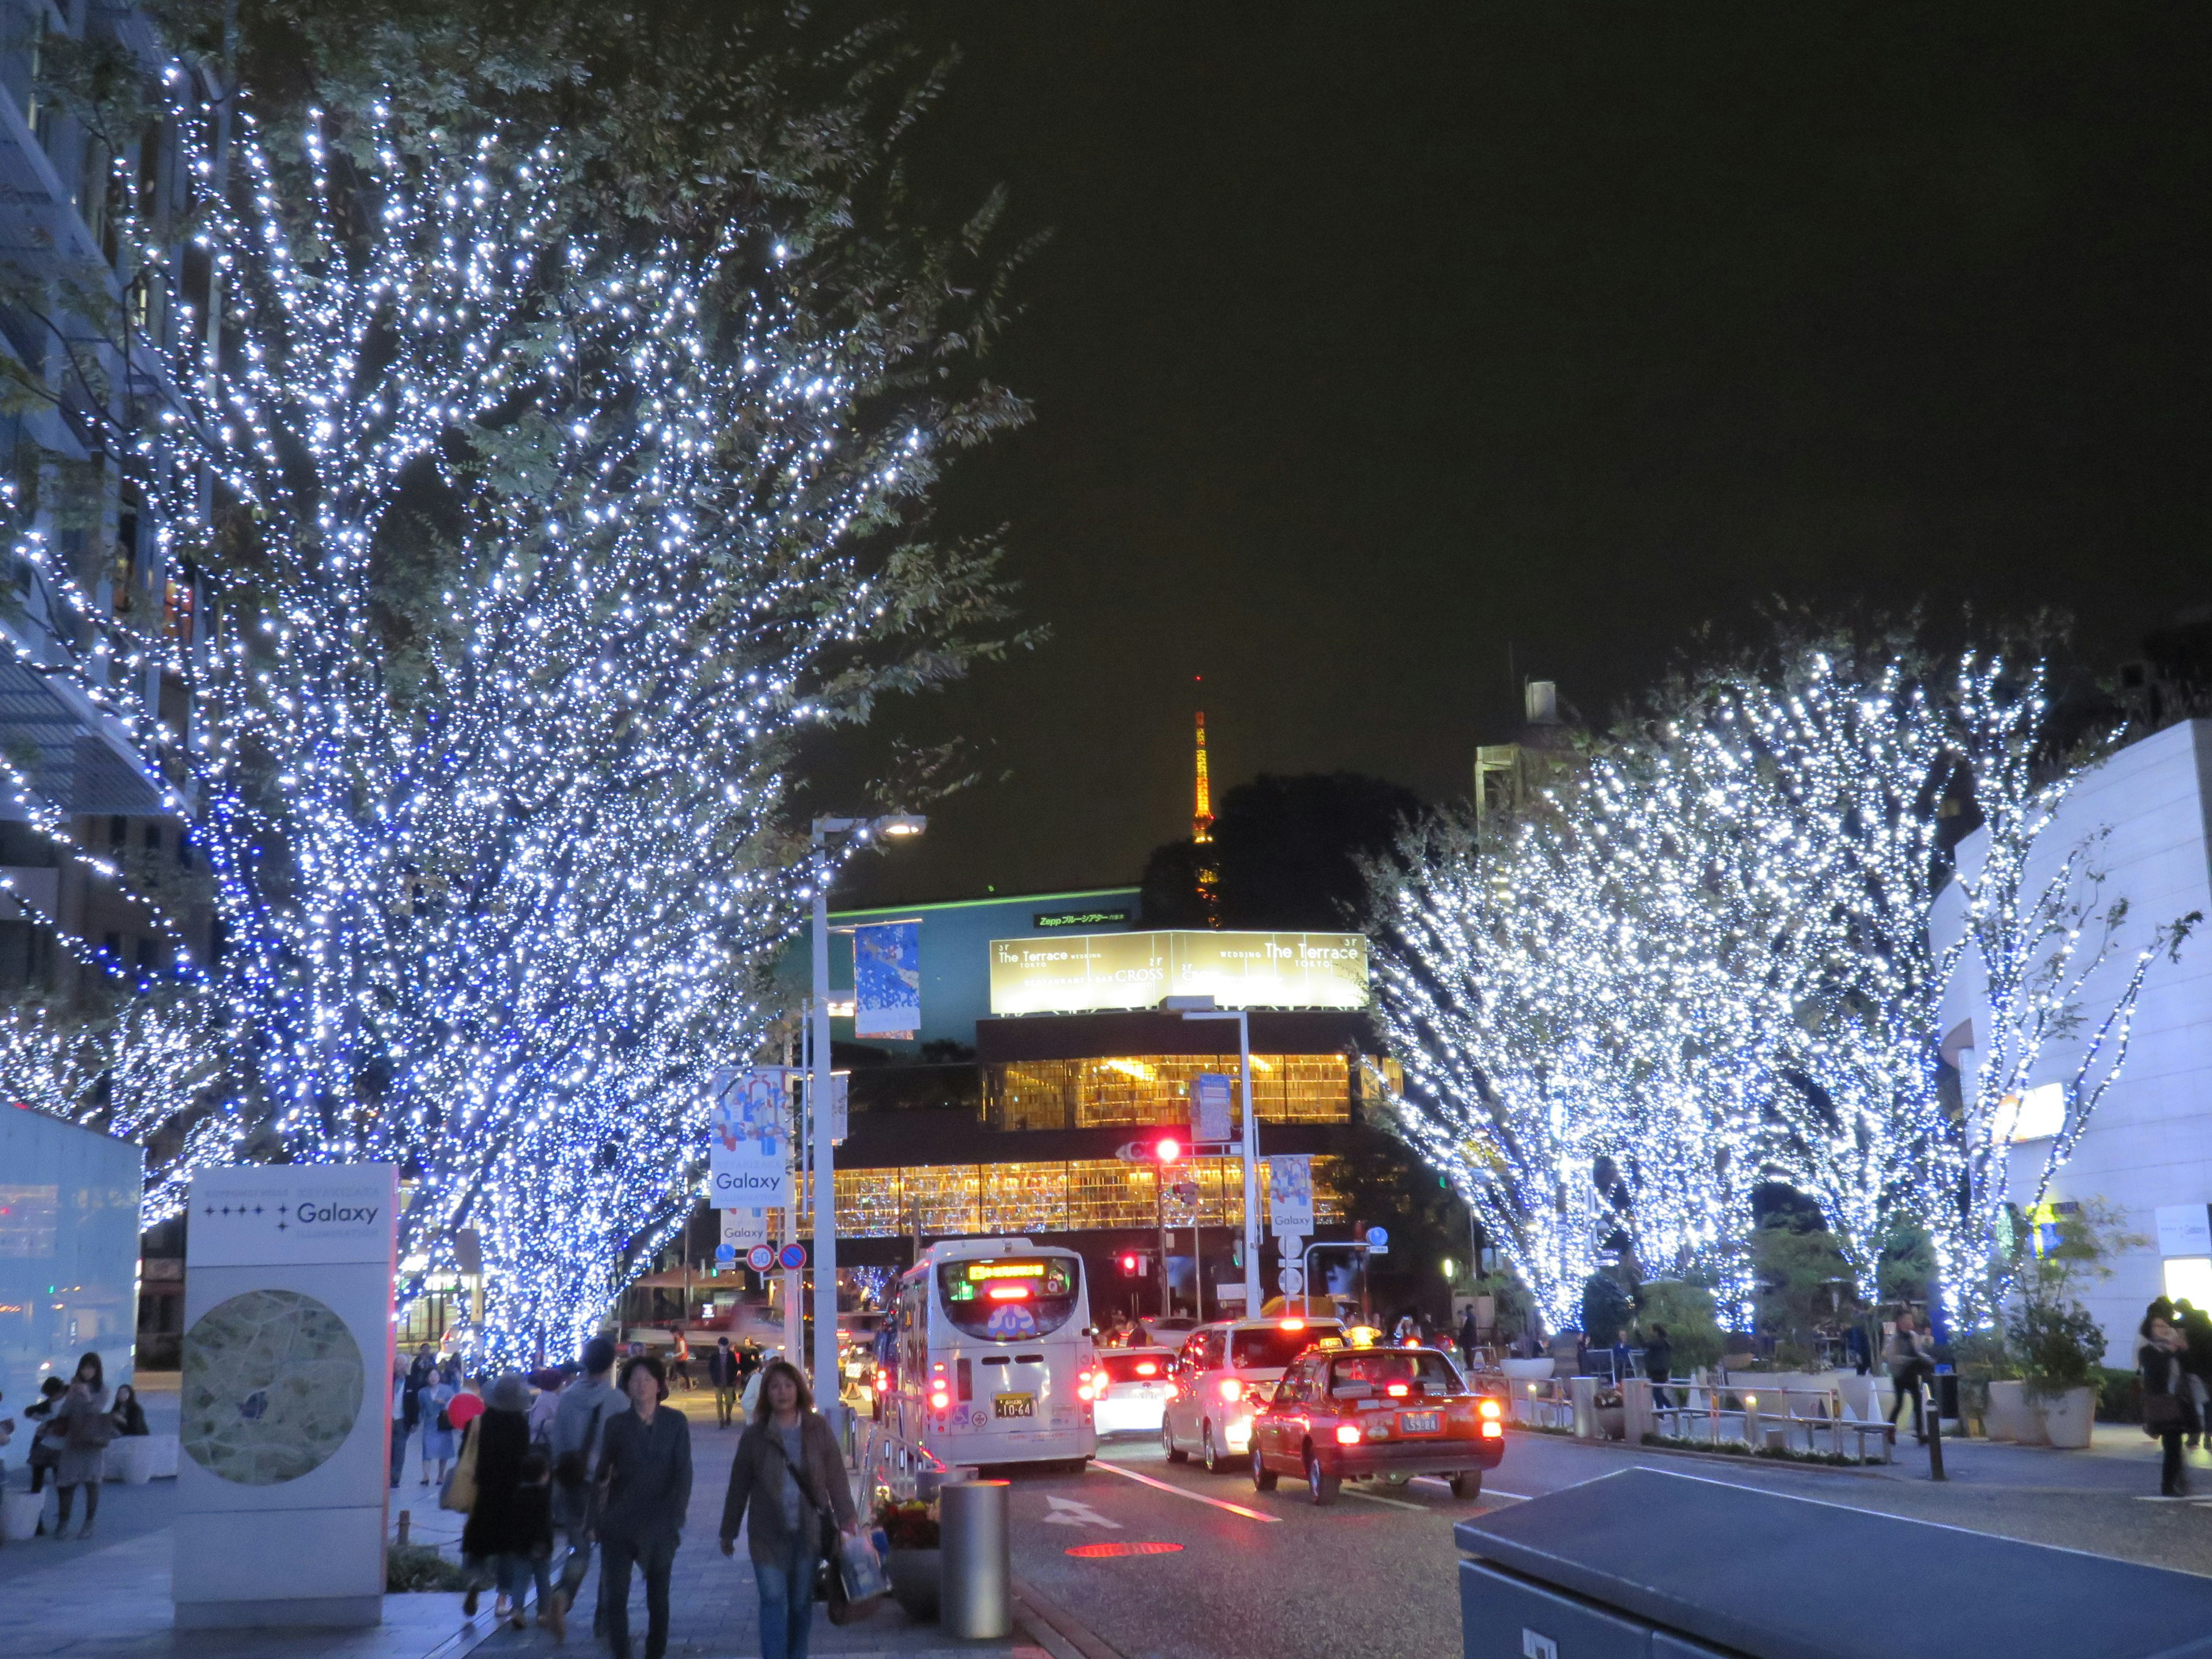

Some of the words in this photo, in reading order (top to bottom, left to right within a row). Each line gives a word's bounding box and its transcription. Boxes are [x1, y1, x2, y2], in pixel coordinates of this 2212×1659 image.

[998, 952, 1019, 963] The
[1023, 950, 1068, 962] Terrace
[1264, 942, 1293, 959] The
[1299, 943, 1358, 959] Terrace
[1149, 957, 1163, 966] 2F
[1295, 960, 1330, 968] TOKYO
[1115, 967, 1164, 983] CROSS
[717, 1172, 781, 1191] Galaxy
[297, 1202, 379, 1225] Galaxy
[1274, 1215, 1310, 1228] Galaxy
[724, 1228, 764, 1239] Galaxy
[753, 1251, 768, 1264] 50
[1003, 1403, 1031, 1416] 10-64
